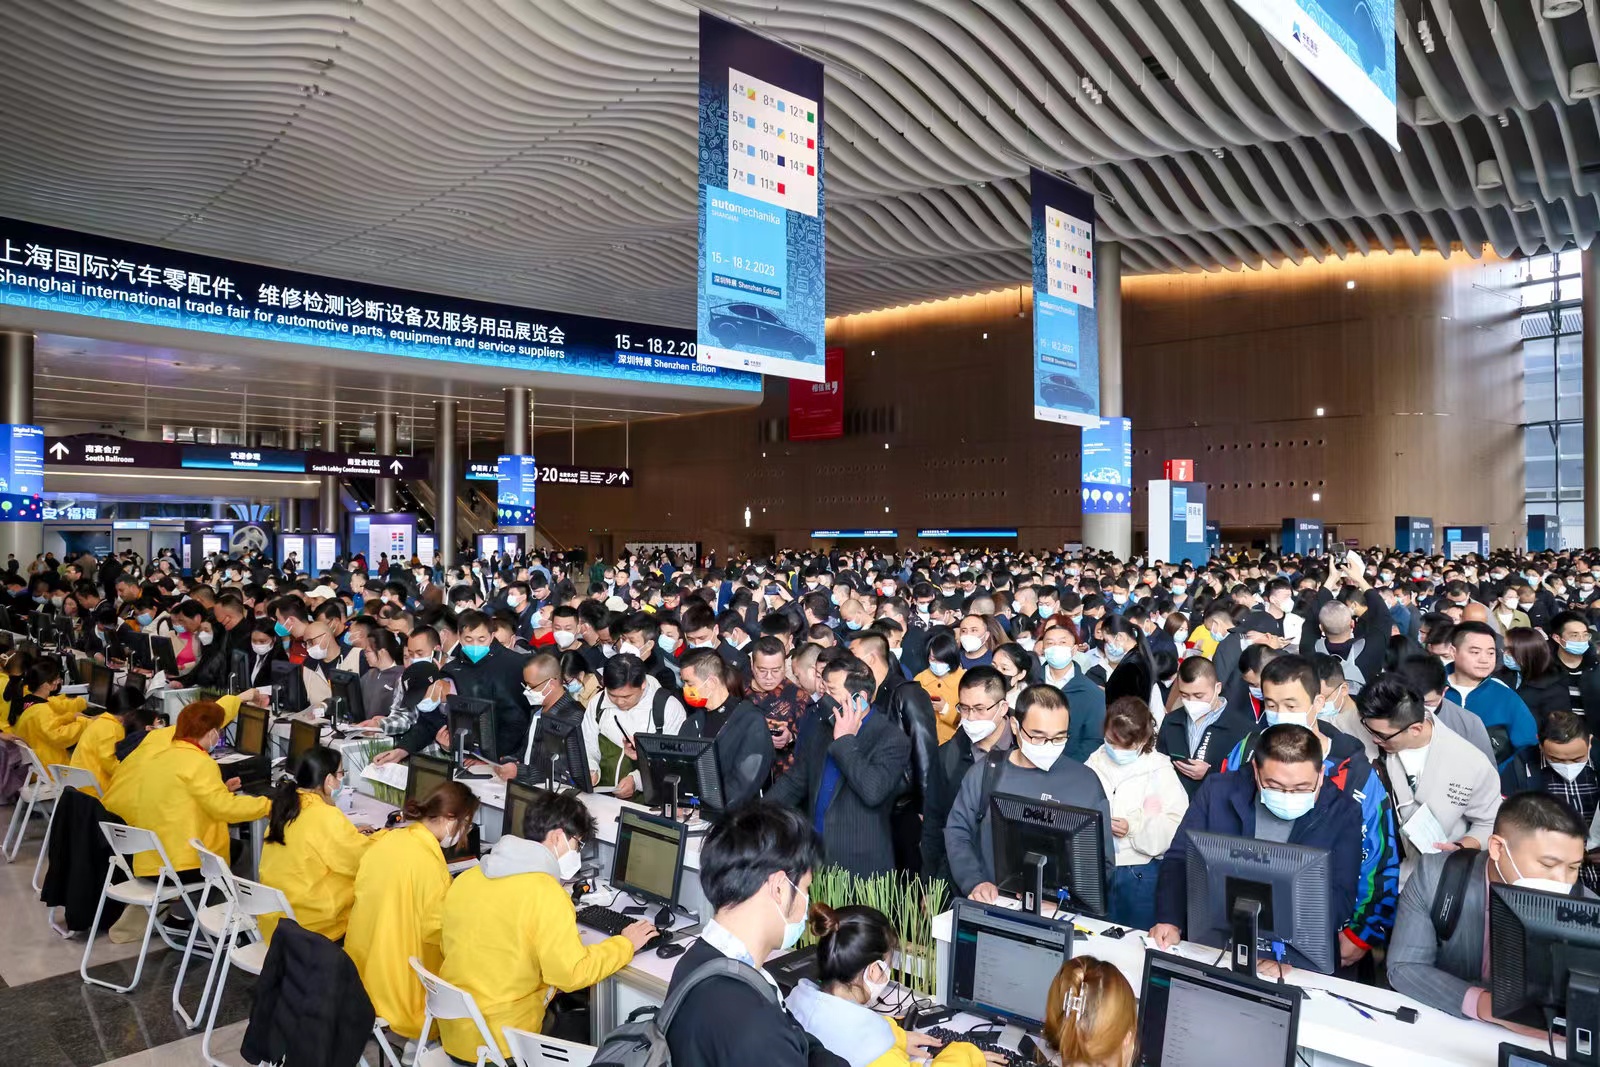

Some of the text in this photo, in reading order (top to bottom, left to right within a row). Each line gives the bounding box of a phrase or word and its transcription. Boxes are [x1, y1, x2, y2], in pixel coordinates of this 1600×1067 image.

[732, 83, 738, 94] 4
[764, 94, 768, 106] 8
[732, 111, 738, 122] 5
[790, 105, 798, 117] 12
[763, 122, 768, 133] 9
[790, 132, 798, 144] 13
[732, 140, 738, 151] 6
[760, 150, 768, 161] 10
[790, 160, 798, 171] 14
[732, 168, 738, 179] 7
[760, 177, 769, 189] 11
[712, 198, 780, 224] automechanika
[712, 251, 722, 264] 15
[733, 256, 775, 277] 18.2.2023
[0, 238, 565, 345] 上海国际汽车零配件、维修检测诊断设备及服务用品展览会
[738, 281, 762, 293] Shenzhen
[763, 286, 780, 296] Edition
[0, 267, 565, 359] Shanghai international trade fair for automotive parts, equipment and service suppliers
[615, 334, 630, 350] 15
[647, 338, 697, 357] 18.2.20
[618, 354, 716, 373] 深圳特展 Shenzhen Edition
[1023, 807, 1054, 823] DELL
[1230, 849, 1270, 864] DELL
